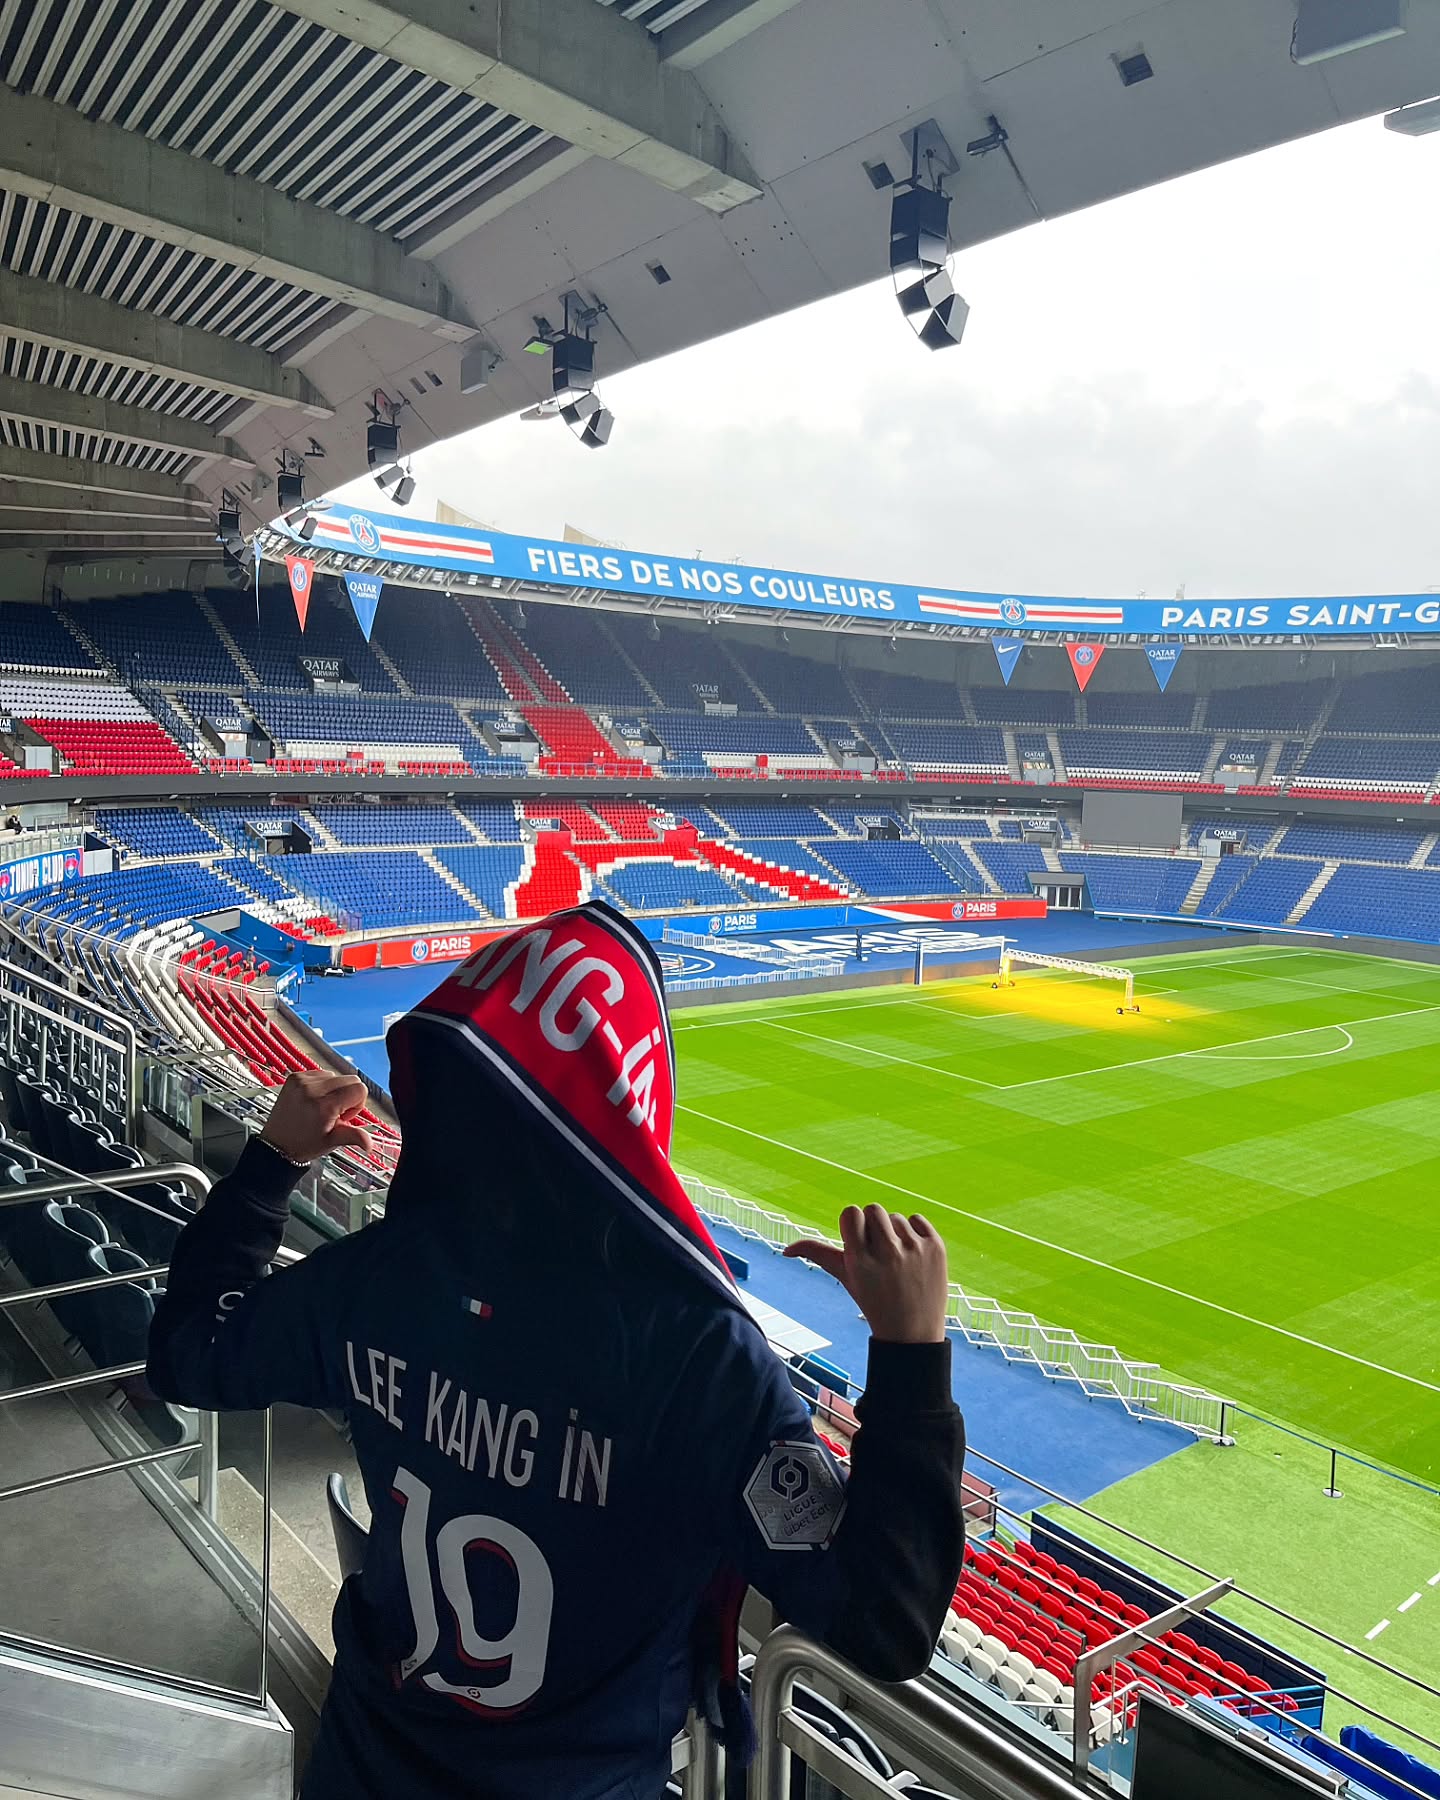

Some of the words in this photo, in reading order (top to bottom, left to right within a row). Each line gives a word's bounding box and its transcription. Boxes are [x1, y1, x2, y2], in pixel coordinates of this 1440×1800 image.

[527, 547, 623, 582] FIERS
[630, 559, 674, 587] DE
[678, 565, 742, 595] NOS
[750, 575, 895, 611] COULEURS
[350, 581, 377, 594] QATAR
[1161, 606, 1270, 628] PARIS
[1286, 601, 1440, 627] SAINT-G
[1149, 649, 1176, 658] QATAR
[303, 660, 339, 671] QATAR
[215, 719, 242, 727] QATAR
[494, 722, 516, 730] QATAR
[1024, 751, 1046, 759] QATAR
[256, 822, 283, 830] QATAR
[1028, 820, 1050, 828] QATAR
[1213, 829, 1237, 838] QATAR
[42, 854, 64, 886] CLUB
[966, 902, 997, 913] PARIS
[724, 914, 757, 927] PARIS
[431, 936, 472, 952] PARIS
[347, 1341, 407, 1431] LEE
[425, 1371, 539, 1487] KANG
[783, 1495, 818, 1522] LIGUE
[392, 1466, 554, 1712] 19
